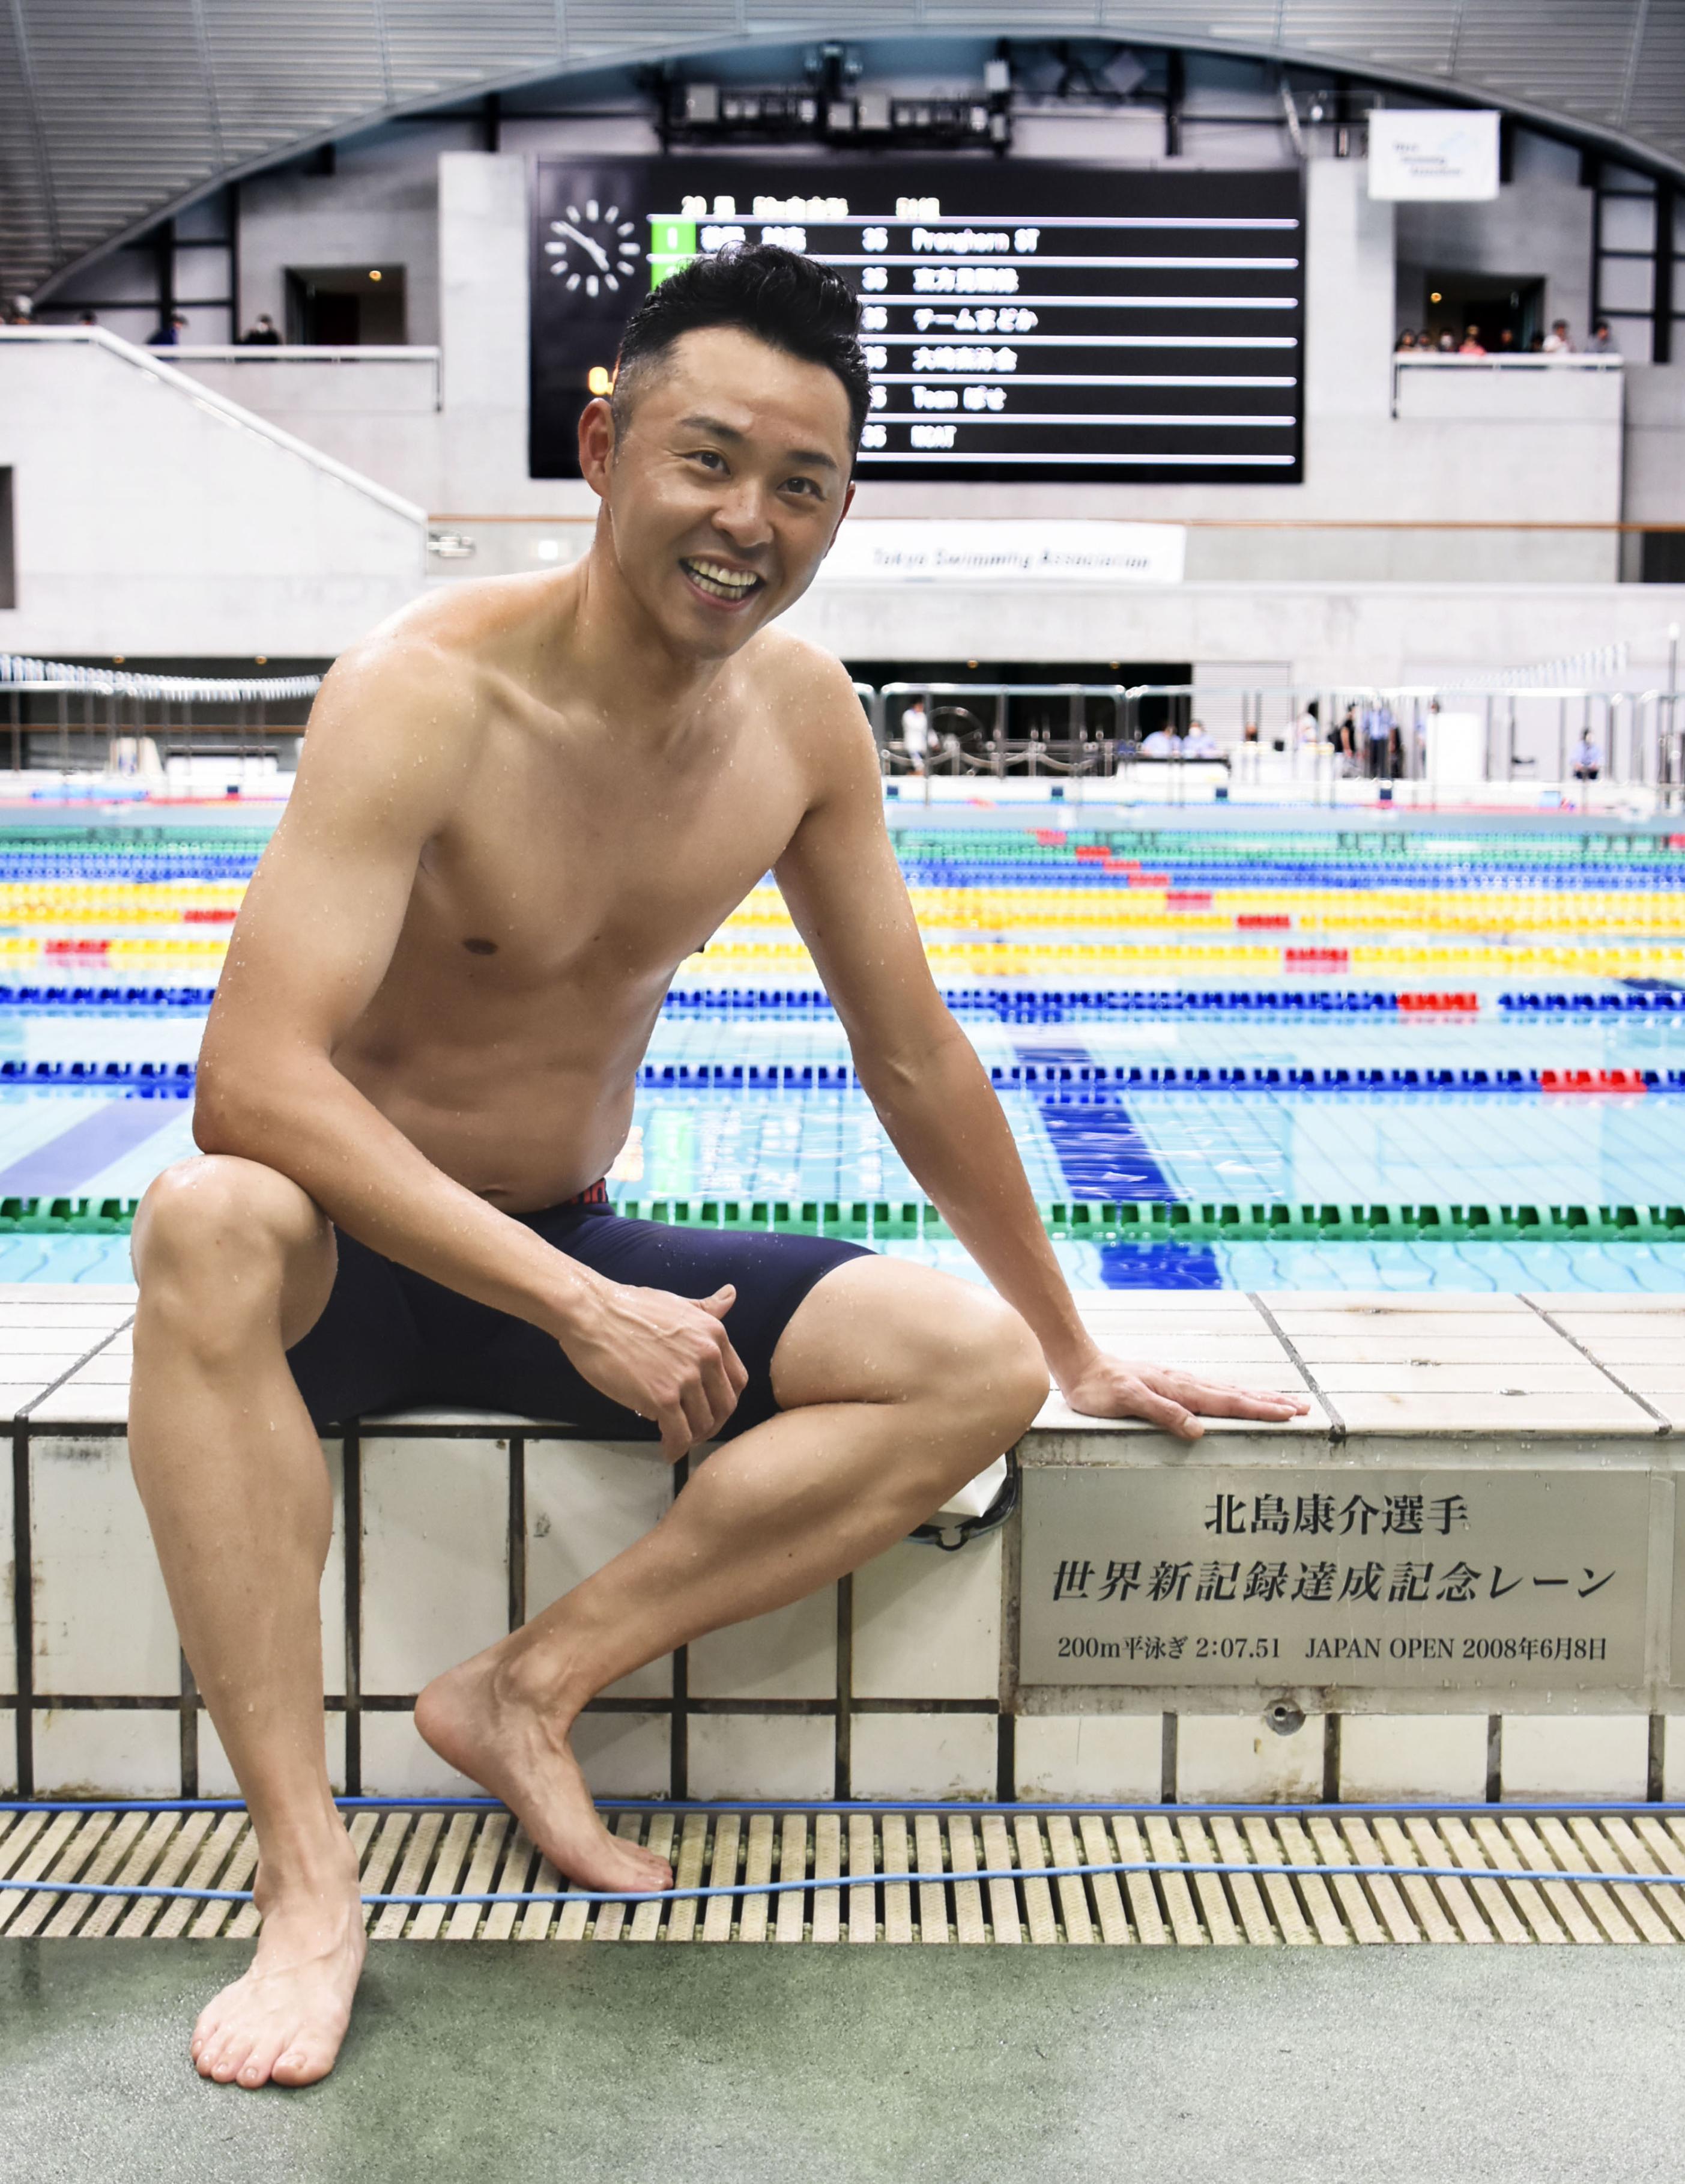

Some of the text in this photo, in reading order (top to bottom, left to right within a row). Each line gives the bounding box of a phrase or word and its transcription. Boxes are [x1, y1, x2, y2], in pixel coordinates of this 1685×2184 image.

[1203, 1493, 1469, 1535] 北島康介選手
[1052, 1559, 1615, 1603] 世界新記録達成記念レーン
[1057, 1635, 1606, 1661] 200m平泳ぎ 2:07.51 JAPAN OPEN 2008年6月8日
